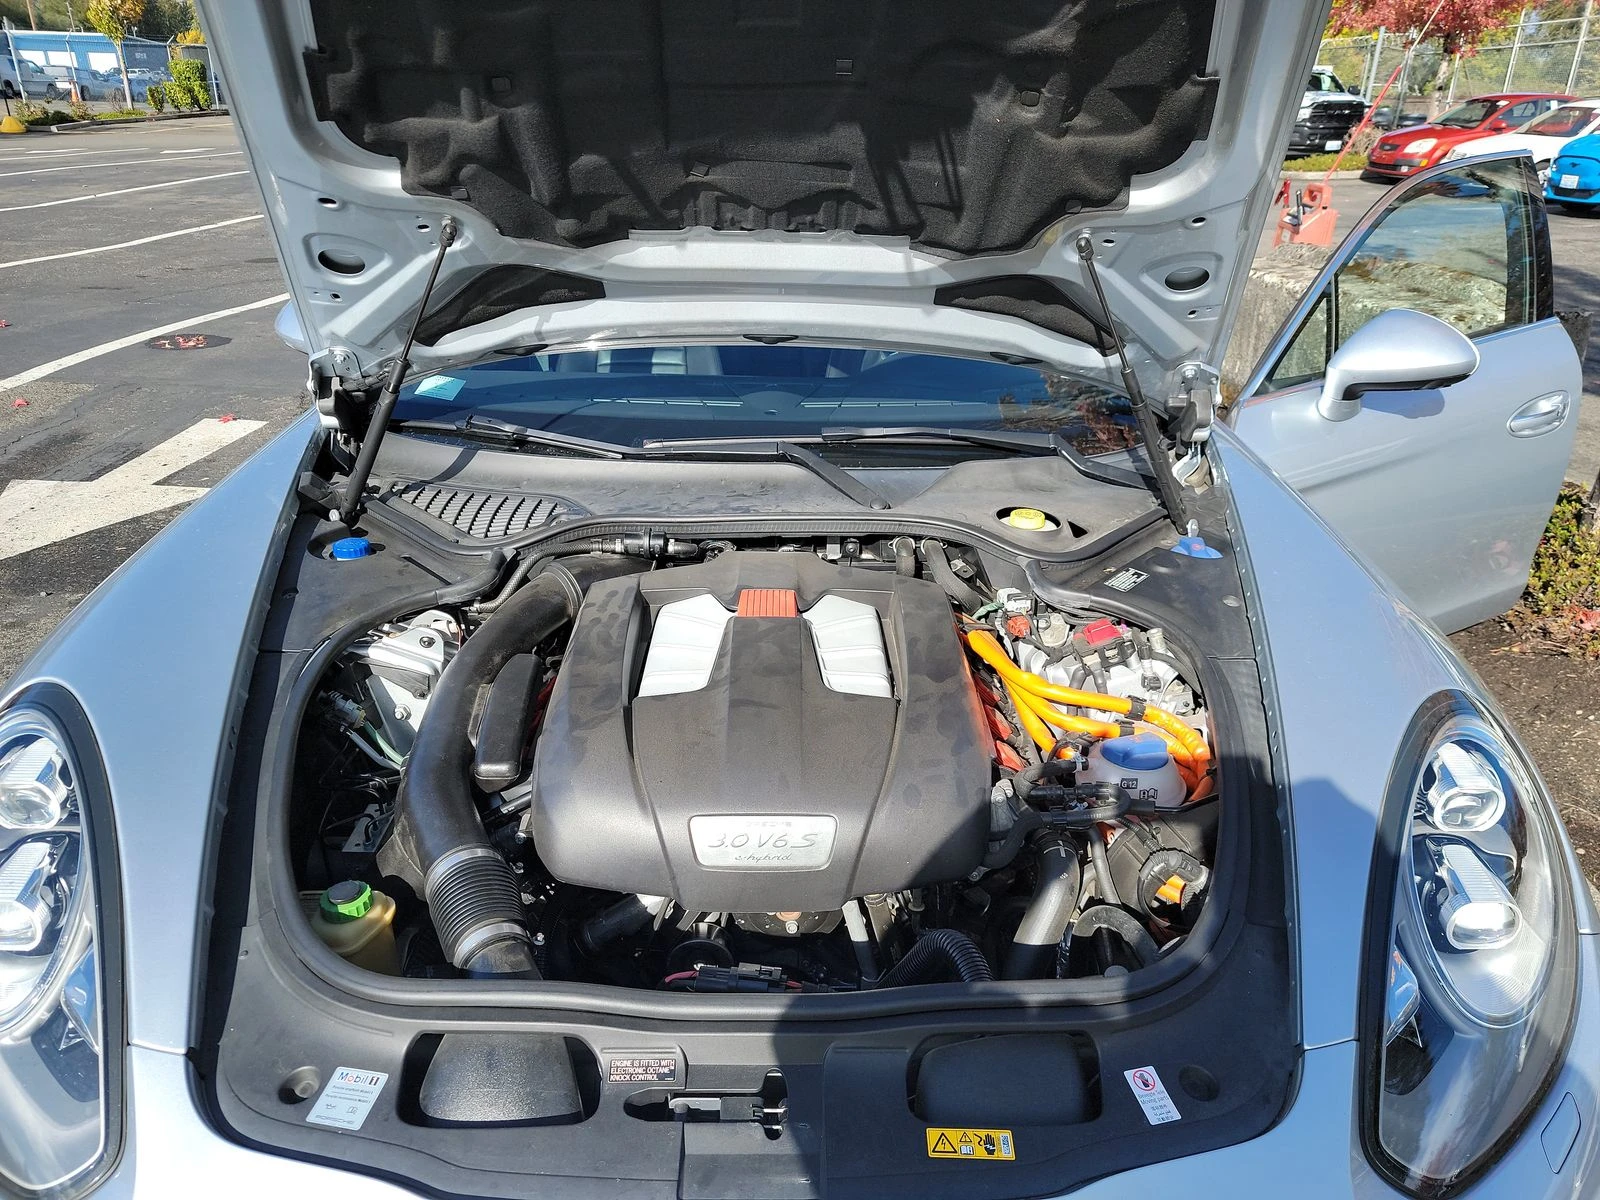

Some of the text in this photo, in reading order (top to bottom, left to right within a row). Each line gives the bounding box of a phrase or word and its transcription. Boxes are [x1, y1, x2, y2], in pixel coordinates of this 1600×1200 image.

[708, 832, 818, 848] 3.0 V6 S
[611, 1059, 675, 1067] ENGINE IS FITTED WITH
[337, 1071, 369, 1085] Mobil
